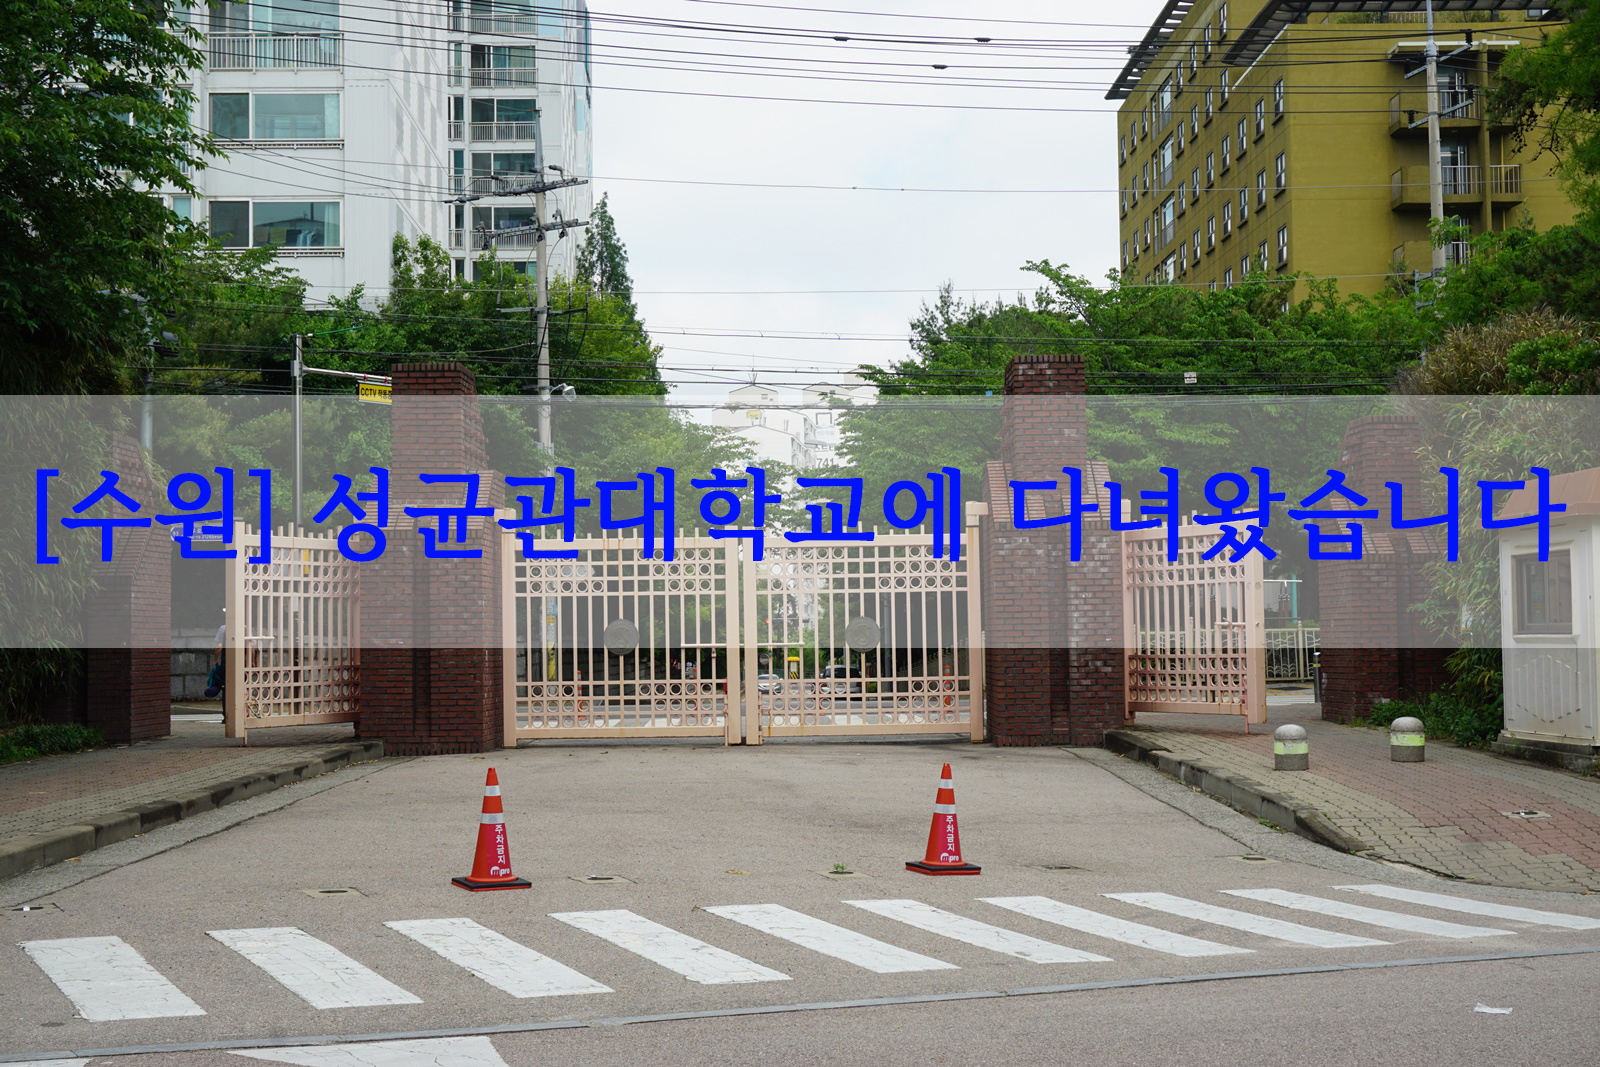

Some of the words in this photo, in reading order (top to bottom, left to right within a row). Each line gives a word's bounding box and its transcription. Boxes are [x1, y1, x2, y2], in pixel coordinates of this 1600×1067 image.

[361, 387, 377, 398] CCTV
[495, 824, 506, 864] 주차금지
[946, 815, 955, 852] 주차금지
